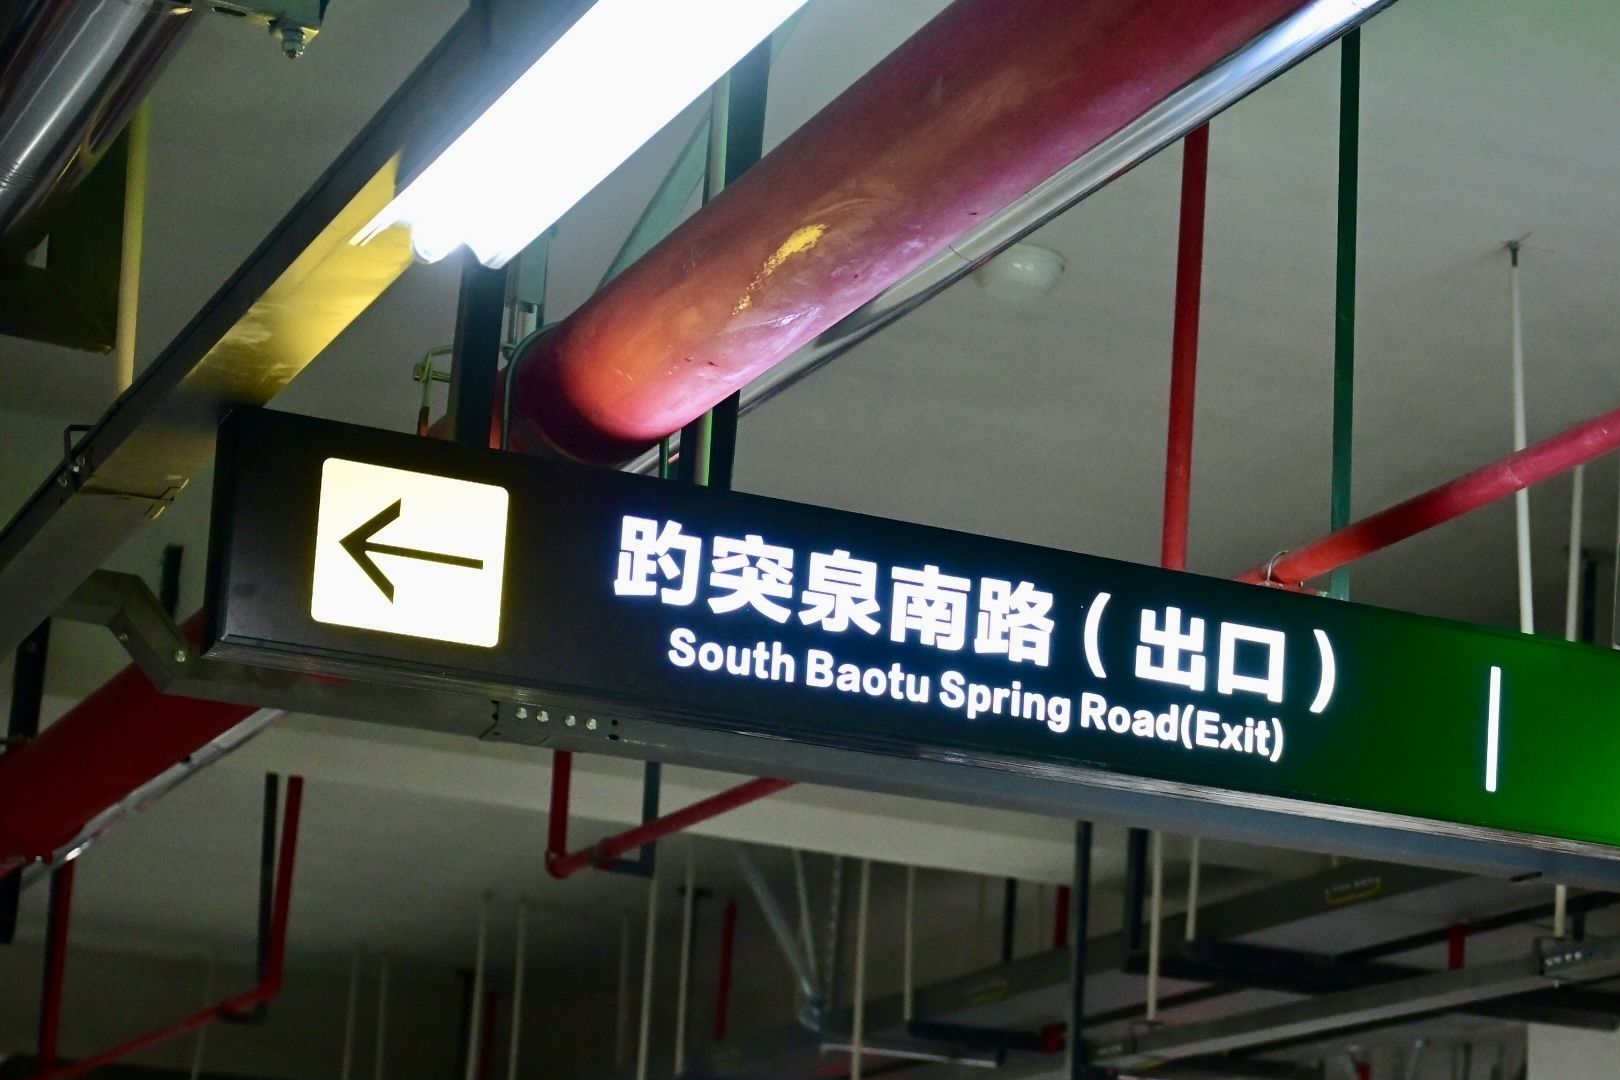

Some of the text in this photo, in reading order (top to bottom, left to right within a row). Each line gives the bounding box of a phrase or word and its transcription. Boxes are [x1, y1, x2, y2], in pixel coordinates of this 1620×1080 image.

[613, 515, 1336, 714] 趵突泉南路（出口）
[668, 627, 1284, 763] South Baotu Spring Road(Exit)
